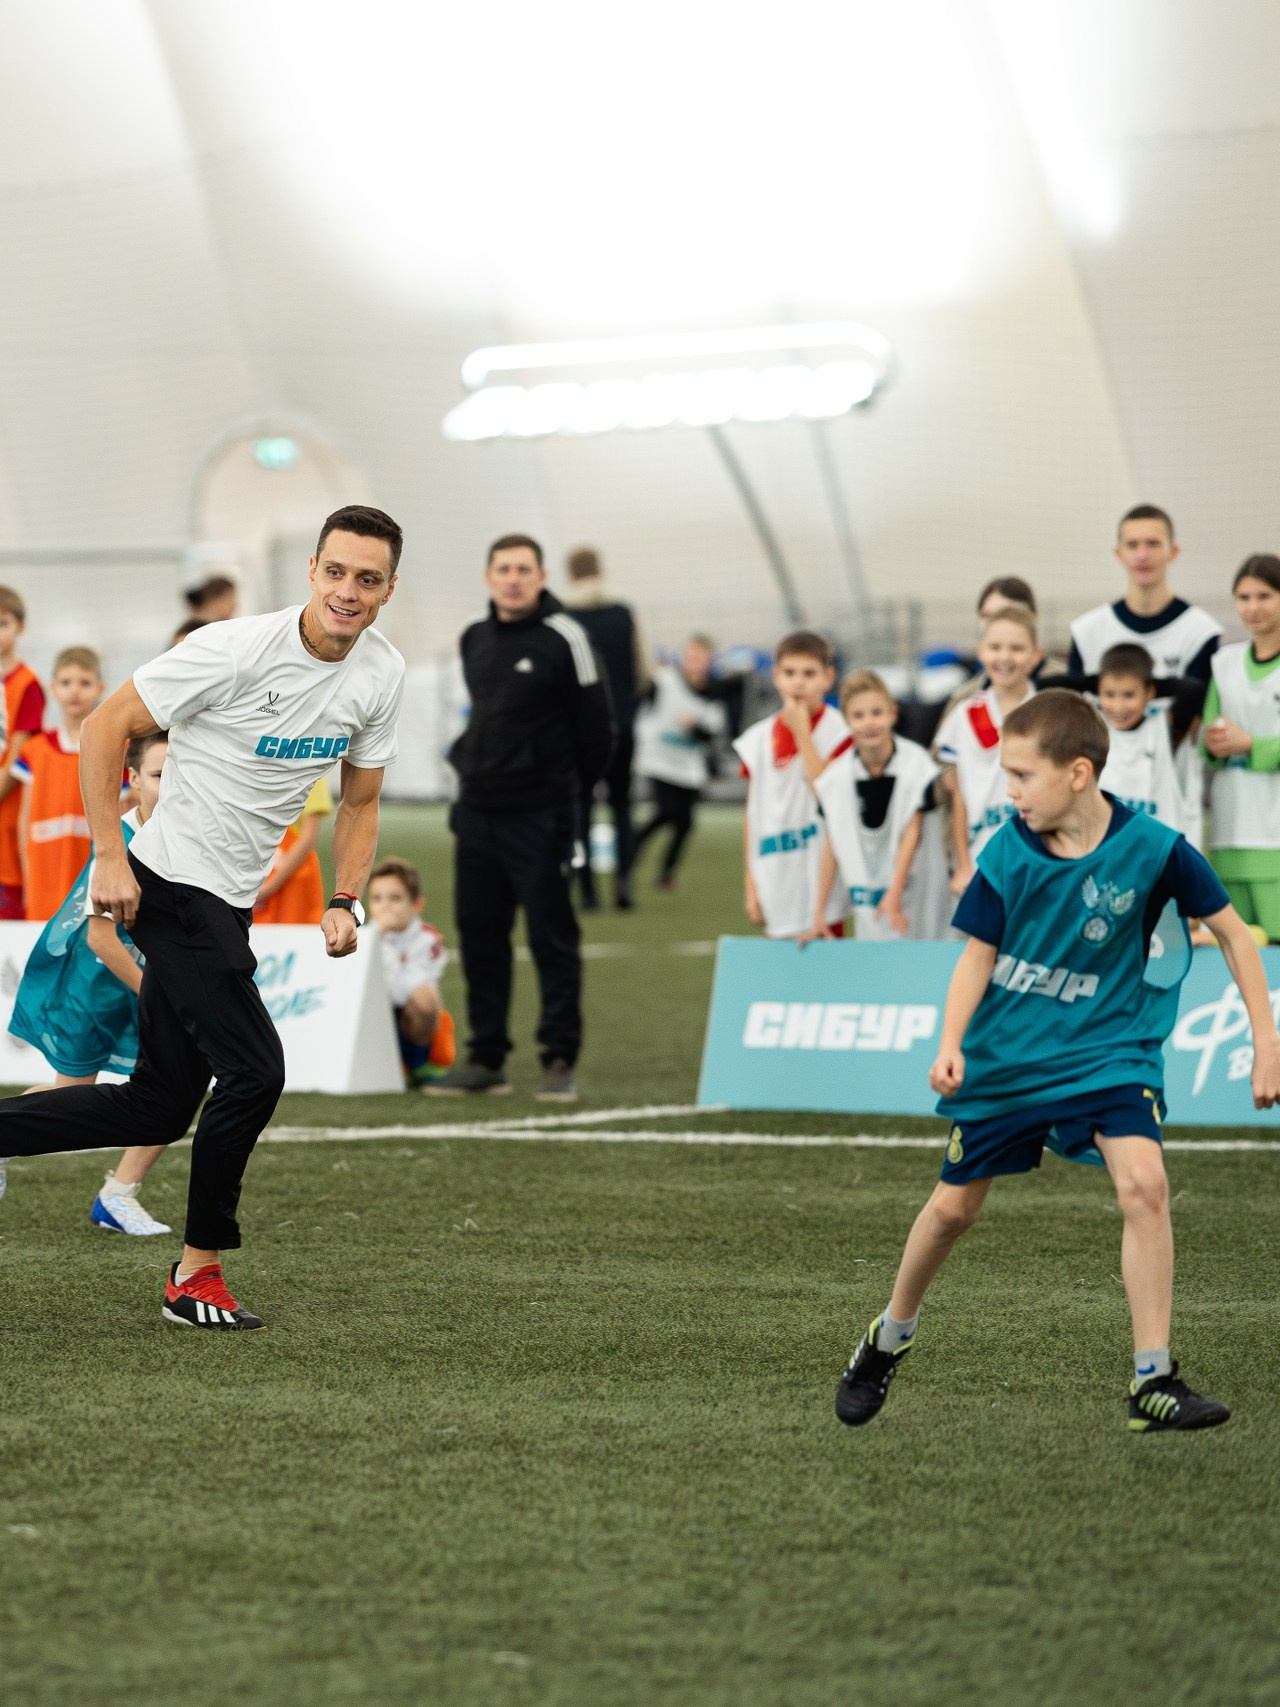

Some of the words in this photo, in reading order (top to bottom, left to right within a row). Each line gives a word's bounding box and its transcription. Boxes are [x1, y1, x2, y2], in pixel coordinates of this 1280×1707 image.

[254, 735, 350, 759] СИБУР
[991, 953, 1100, 1003] ИБУР
[741, 1000, 938, 1052] СИБУР
